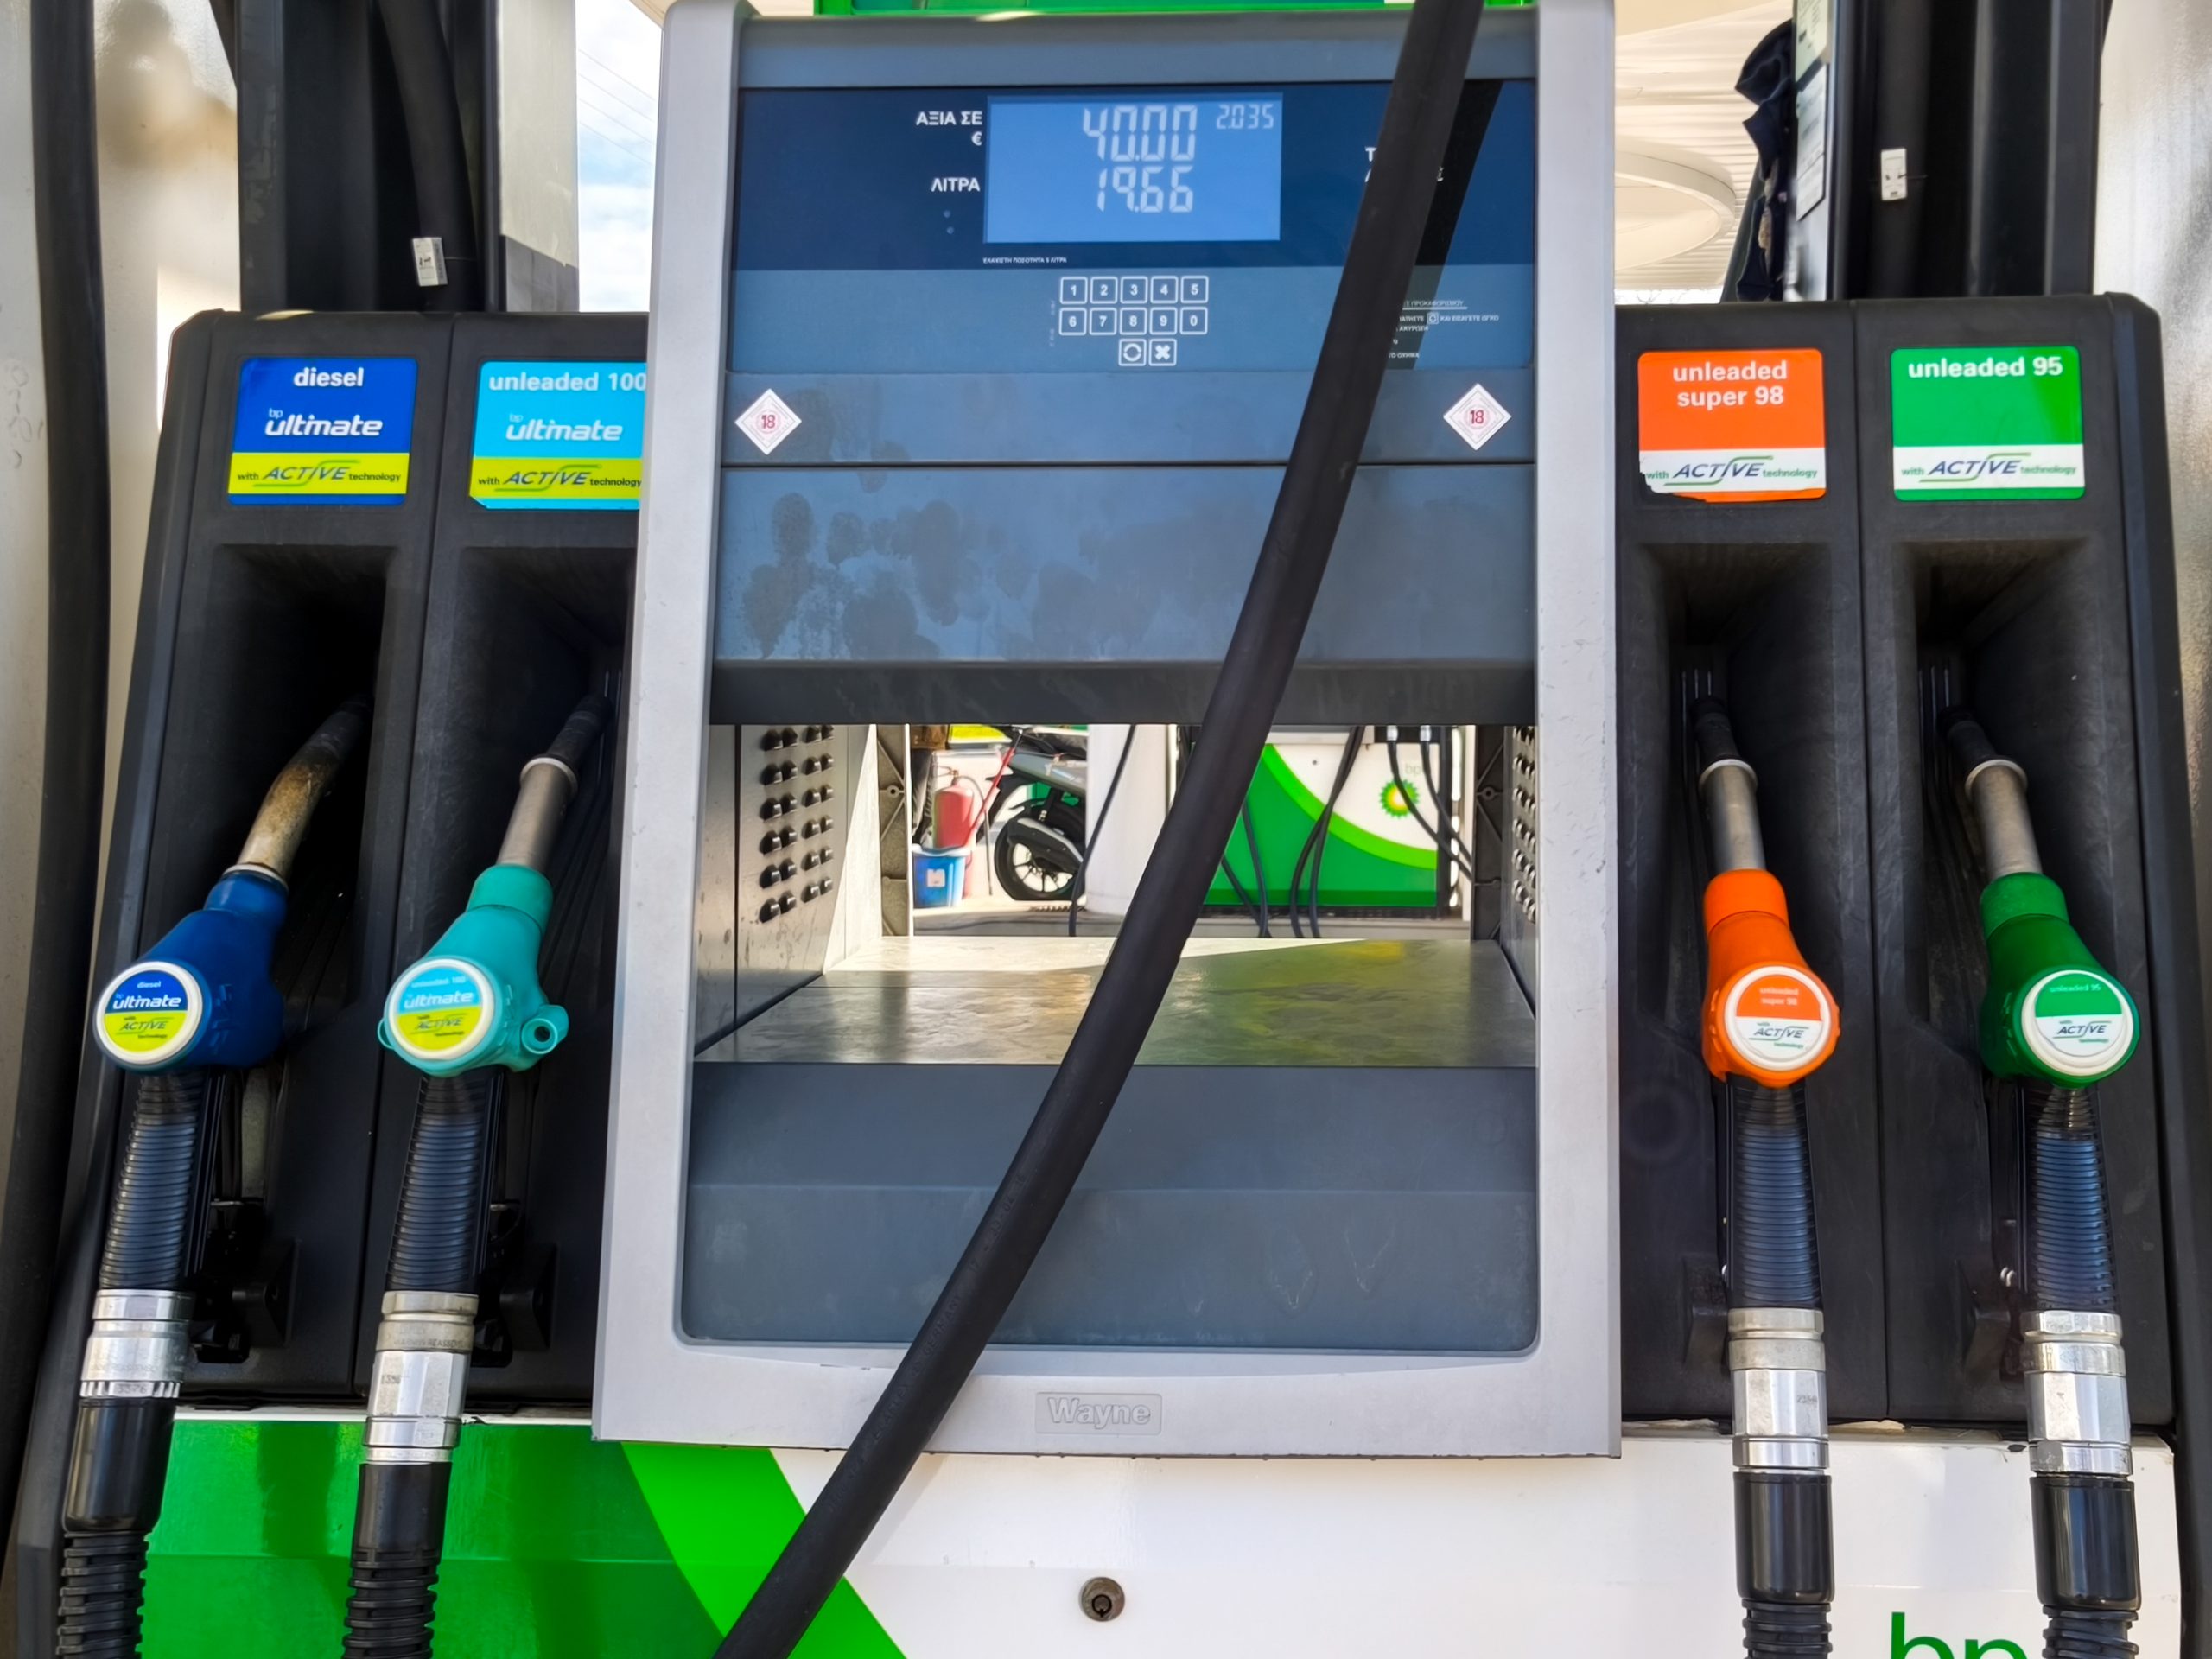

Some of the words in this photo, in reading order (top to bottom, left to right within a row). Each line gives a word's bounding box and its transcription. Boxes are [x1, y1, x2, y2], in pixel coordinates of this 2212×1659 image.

[916, 111, 956, 126] ΑΞΙΑ
[960, 111, 982, 126] ΣΕ
[931, 177, 981, 192] ΛΙΤΡΑ
[1070, 285, 1077, 296] 1
[1100, 284, 1108, 296] 2
[1130, 284, 1138, 296] 3
[1160, 284, 1168, 295] 4
[1191, 283, 1198, 295] 5
[1069, 315, 1077, 327] 6
[1099, 315, 1107, 327] 7
[1129, 315, 1137, 327] 8
[1160, 315, 1167, 327] 9
[1190, 315, 1198, 326] 0
[1673, 360, 1788, 382] unleaded
[1908, 356, 2026, 378] unleaded
[2032, 355, 2063, 376] 95
[293, 367, 365, 387] diesel
[488, 372, 599, 391] unleaded
[608, 372, 646, 391] 100
[1677, 390, 1747, 411] super
[1754, 385, 1784, 405] 98
[269, 408, 283, 419] bp
[1470, 410, 1484, 424] 18
[264, 414, 383, 436] ultimate
[761, 415, 775, 429] 18
[505, 419, 623, 441] ultimate
[263, 467, 351, 480] ACTIVE
[349, 472, 402, 482] technology
[1646, 470, 1669, 480] with
[1673, 462, 1764, 478] ACTIVE
[1763, 468, 1818, 478] technology
[1901, 467, 1924, 476] with
[1928, 460, 2022, 475] ACTIVE
[2021, 466, 2076, 475] technology
[478, 477, 500, 486] with
[503, 471, 592, 485] ACTIVE
[590, 478, 642, 487] technology
[137, 980, 162, 988] diesel
[112, 994, 181, 1009] ultimate
[404, 991, 474, 1009] ultimate
[120, 1020, 168, 1031] ACTIVE
[1753, 1027, 1804, 1039] ACTIVE
[2056, 1025, 2107, 1034] ACTIVE
[1047, 1397, 1151, 1430] Wayne
